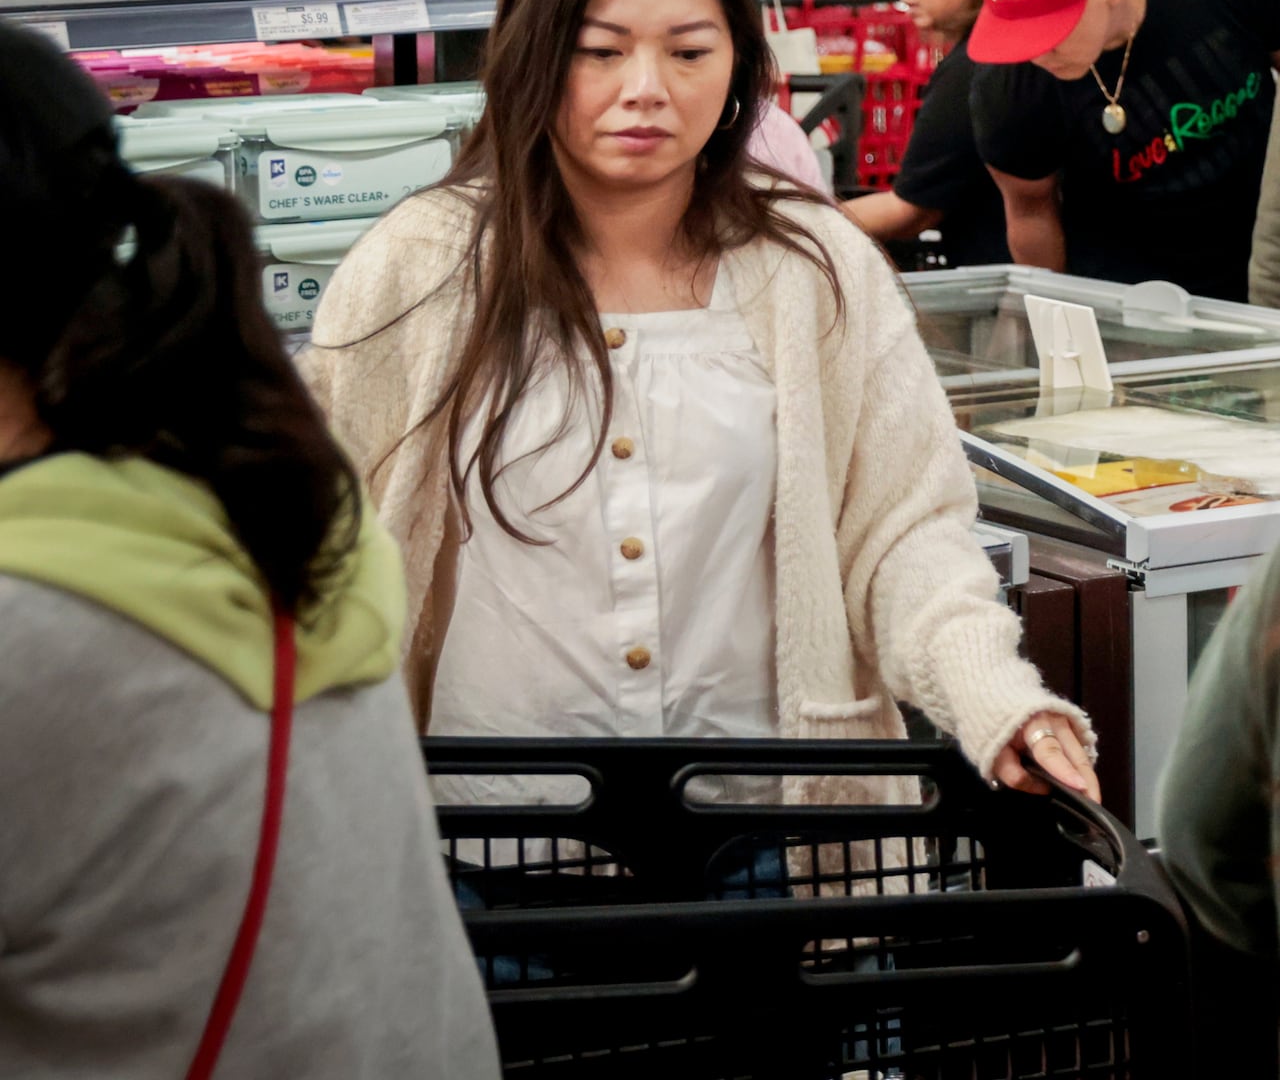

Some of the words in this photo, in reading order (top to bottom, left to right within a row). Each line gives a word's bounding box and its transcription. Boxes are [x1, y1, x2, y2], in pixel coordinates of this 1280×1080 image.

[301, 11, 329, 25] $5.99
[1112, 136, 1168, 183] Love
[314, 193, 345, 206] WARE
[347, 191, 390, 204] CLEAR+
